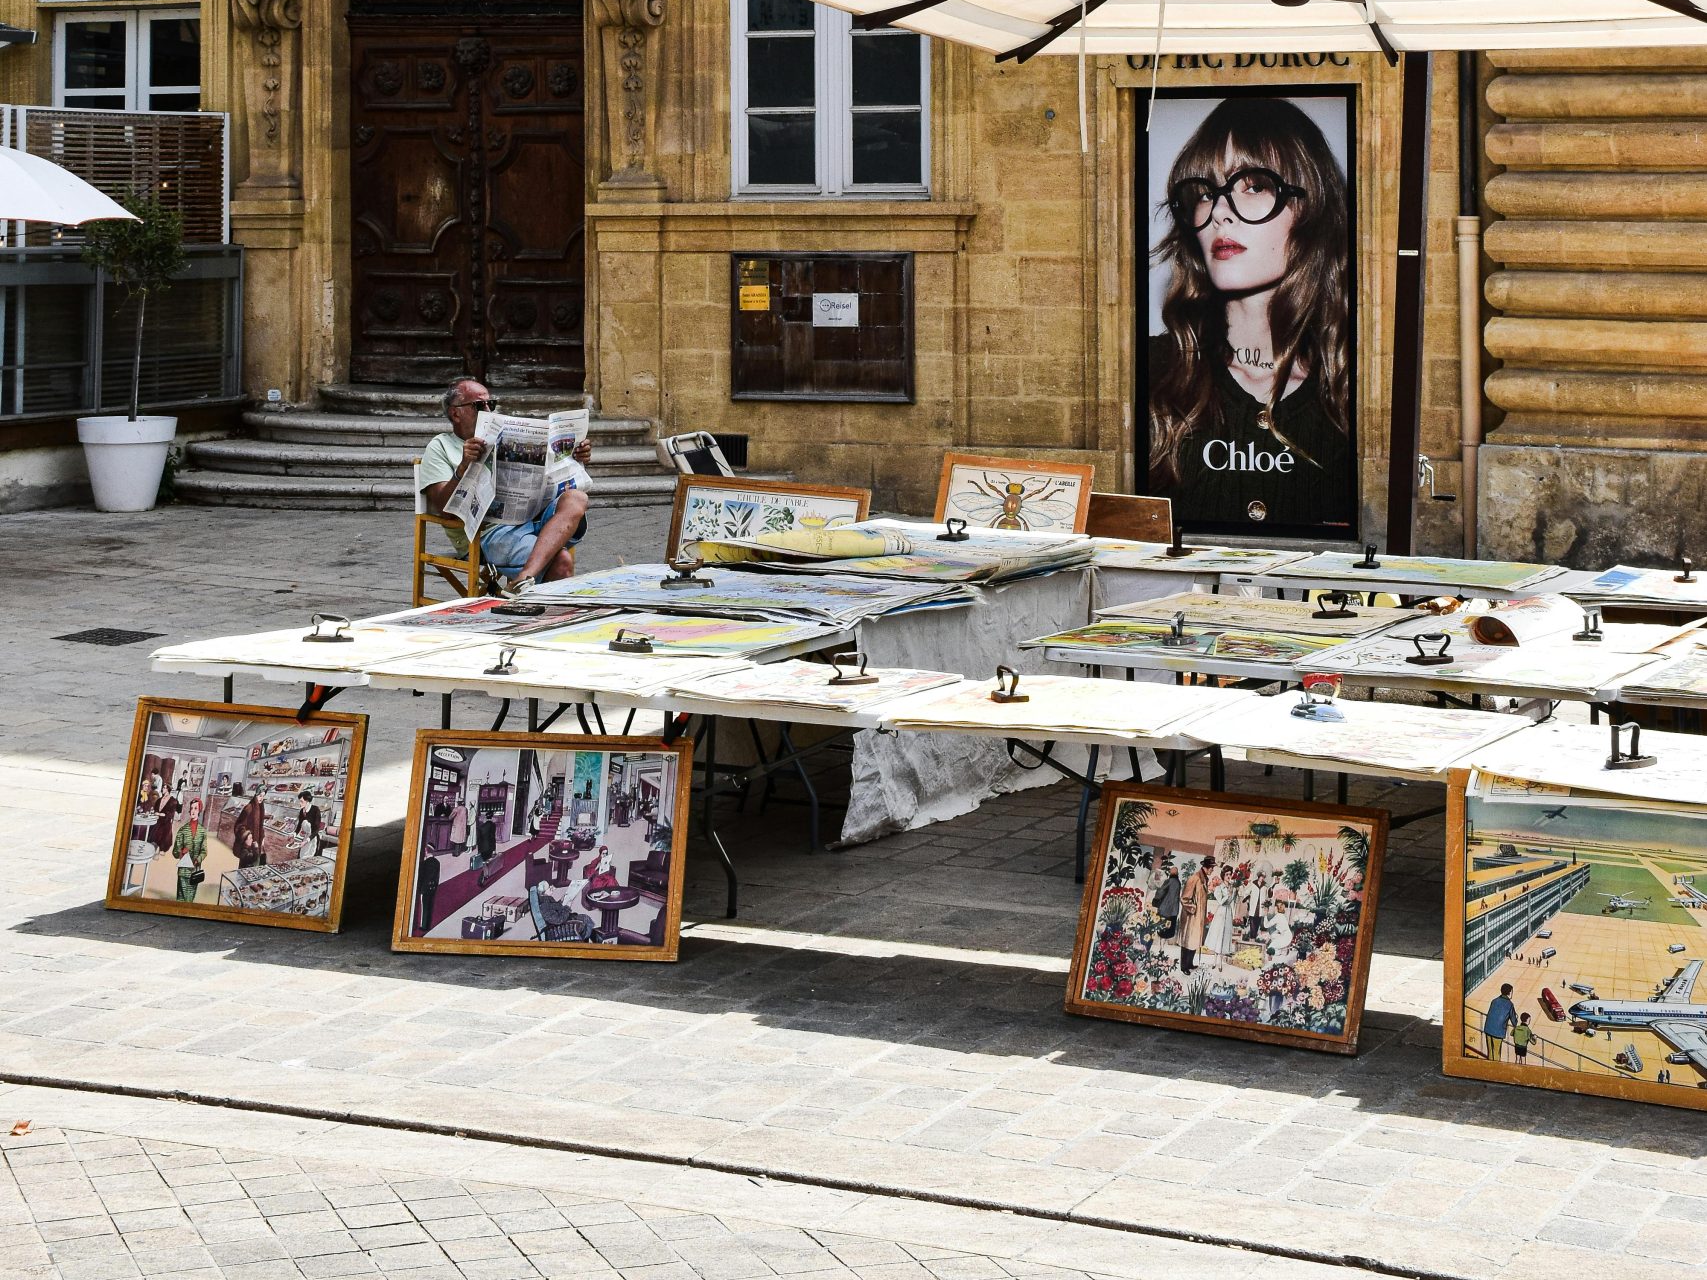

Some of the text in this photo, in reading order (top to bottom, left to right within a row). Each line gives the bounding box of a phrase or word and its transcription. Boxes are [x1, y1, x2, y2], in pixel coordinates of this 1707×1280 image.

[830, 301, 852, 309] Reisel
[1203, 439, 1294, 473] Chloé
[771, 496, 781, 505] DE
[785, 497, 809, 507] TABLE
